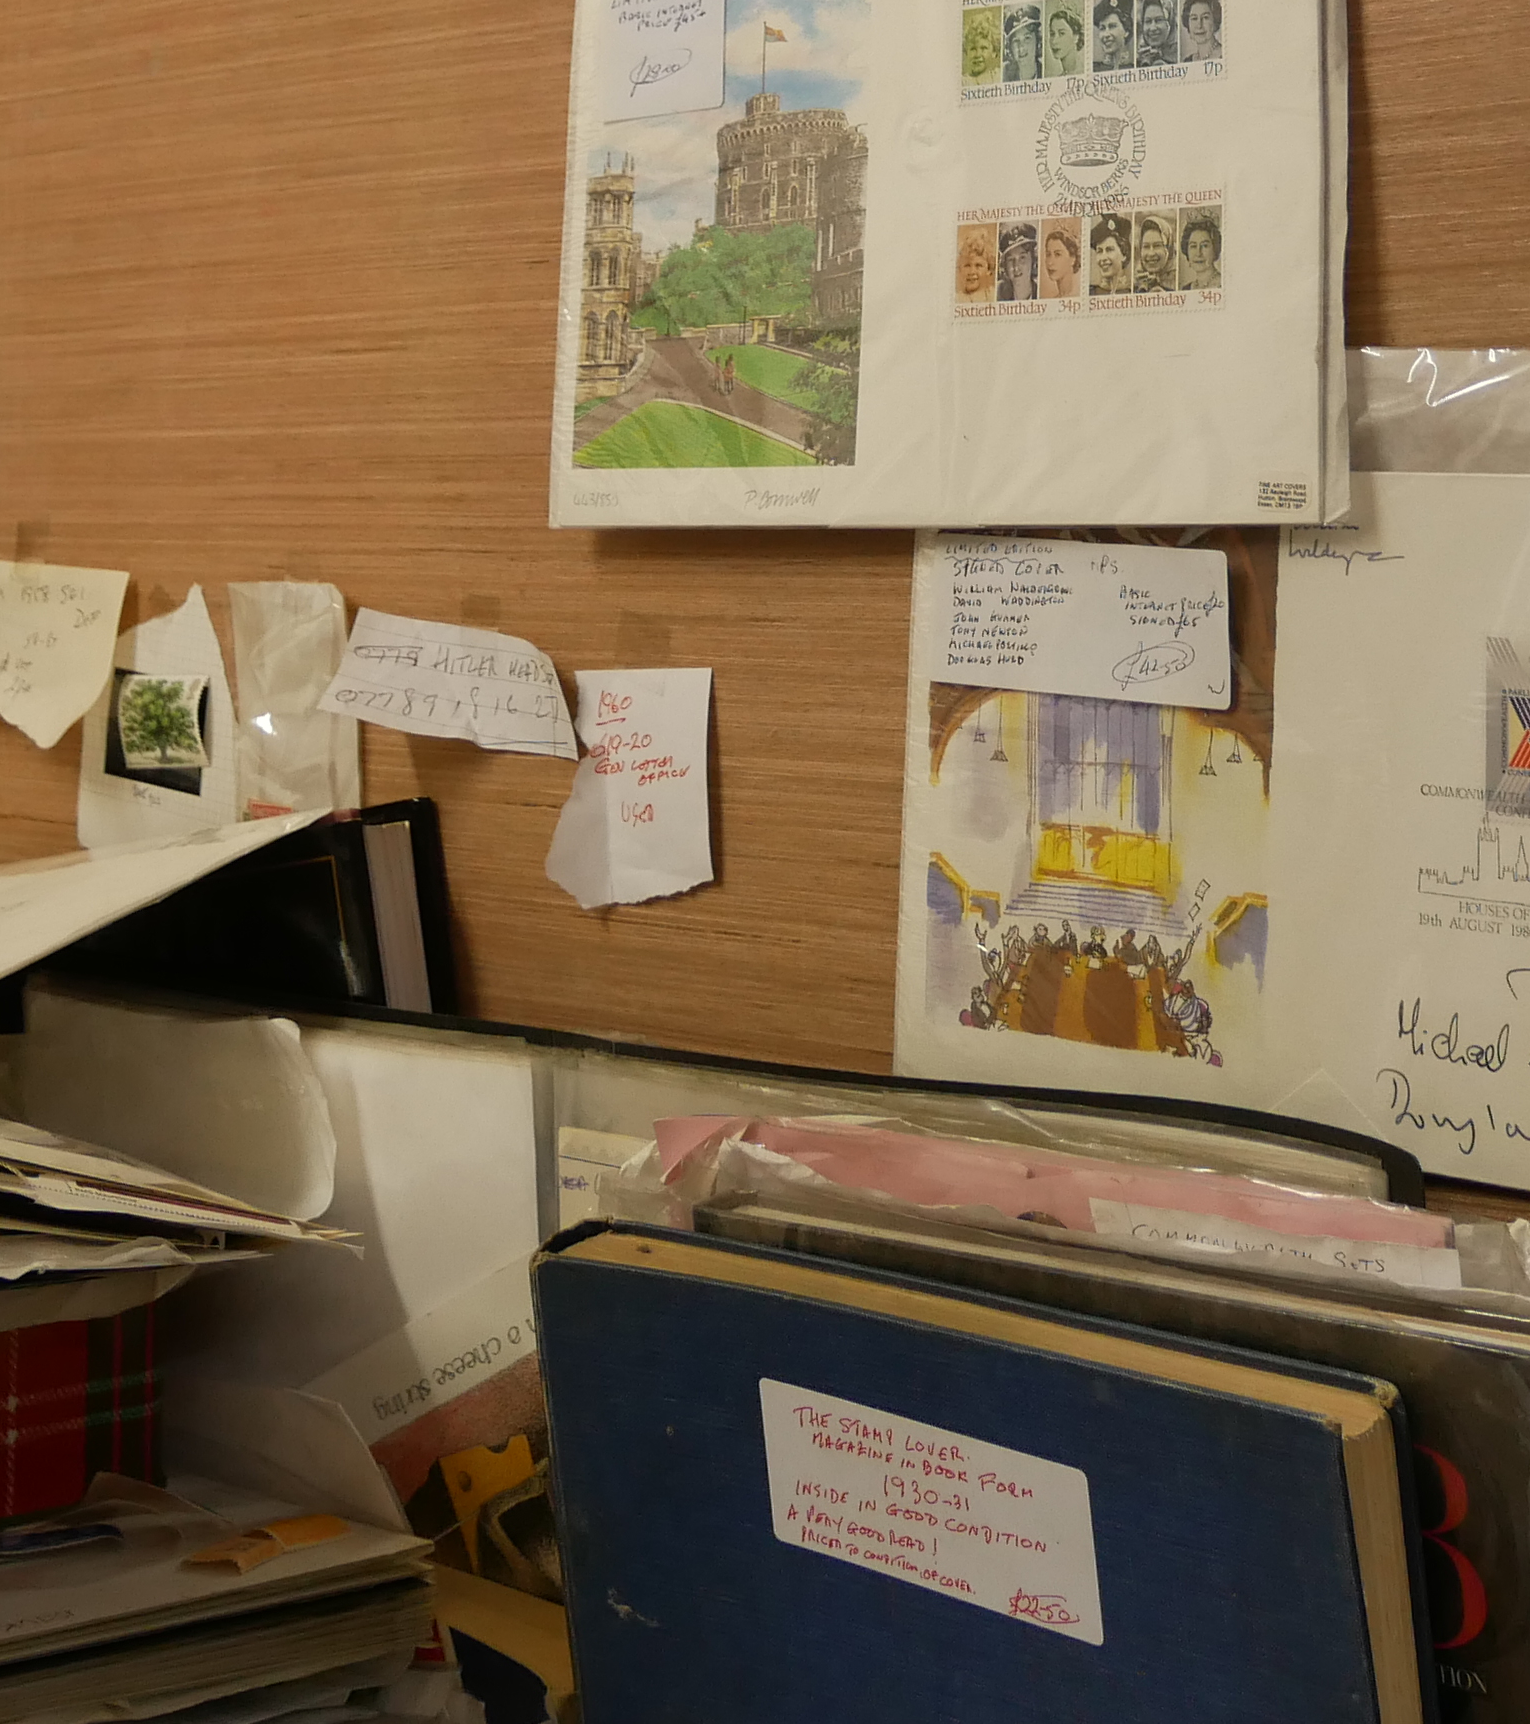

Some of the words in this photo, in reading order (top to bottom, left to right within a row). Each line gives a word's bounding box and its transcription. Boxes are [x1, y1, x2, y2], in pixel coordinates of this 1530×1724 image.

[1138, 64, 1188, 82] Birthday
[1203, 61, 1223, 77] 17p
[961, 84, 1002, 101] Sixtieth
[1004, 80, 1052, 97] Birthday
[1054, 167, 1099, 199] WINDSOR
[1162, 192, 1183, 205] THE
[1184, 188, 1222, 205] QUEEN
[957, 210, 980, 222] HER
[979, 206, 1022, 220] MAJESTY
[1024, 204, 1044, 216] THE
[954, 304, 996, 318] Sixtieth
[998, 300, 1047, 316] Birthday
[1058, 298, 1081, 314] 34p
[1089, 296, 1133, 312] Sixtieth
[1135, 292, 1187, 308] Birthday
[1197, 290, 1221, 305] 34p
[1419, 913, 1442, 927] 19th
[1449, 918, 1502, 934] AUGUST
[1458, 901, 1510, 919] HOUSES
[1512, 907, 1530, 920] OF
[432, 1336, 501, 1386] cheese
[372, 1378, 431, 1421] string
[792, 1406, 833, 1429] THE
[839, 1417, 894, 1447] STAMP
[811, 1431, 894, 1465] MAGAZINE
[900, 1458, 917, 1471] IN
[922, 1459, 969, 1484] BOOK
[978, 1472, 1035, 1499] FORM
[883, 1474, 970, 1512] 1930-31
[786, 1504, 799, 1521] A
[806, 1508, 844, 1535] VERY
[846, 1521, 885, 1545] GOOD
[795, 1479, 849, 1505] INSIDE
[858, 1500, 877, 1512] IN
[885, 1502, 938, 1527] GOOD
[944, 1517, 1048, 1554] CONDITION
